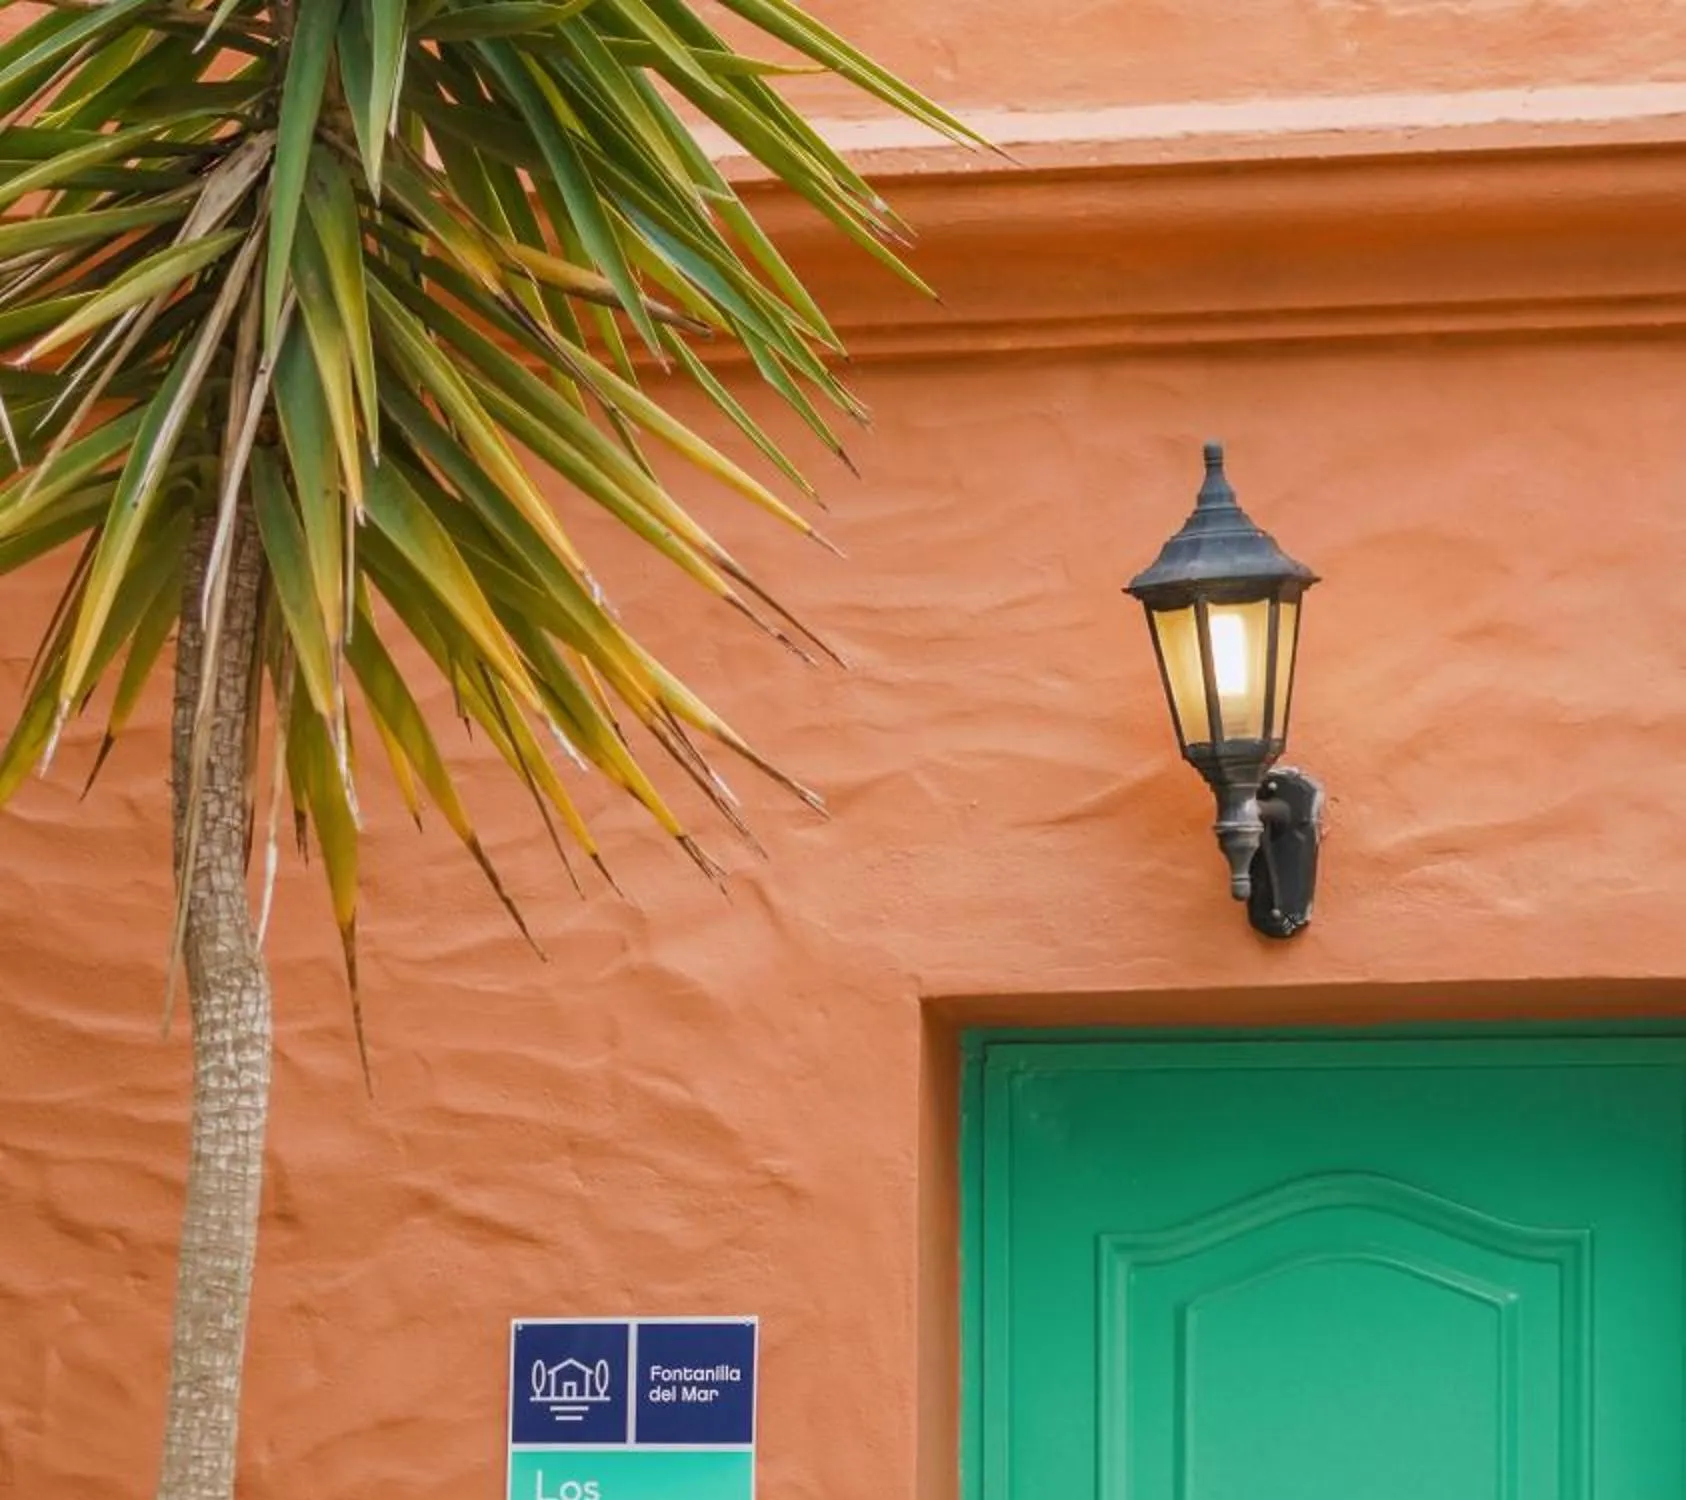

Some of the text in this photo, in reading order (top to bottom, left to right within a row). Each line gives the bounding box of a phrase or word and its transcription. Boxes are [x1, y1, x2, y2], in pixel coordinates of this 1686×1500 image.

[650, 1364, 741, 1382] Fontanilla
[648, 1385, 719, 1402] del Mar
